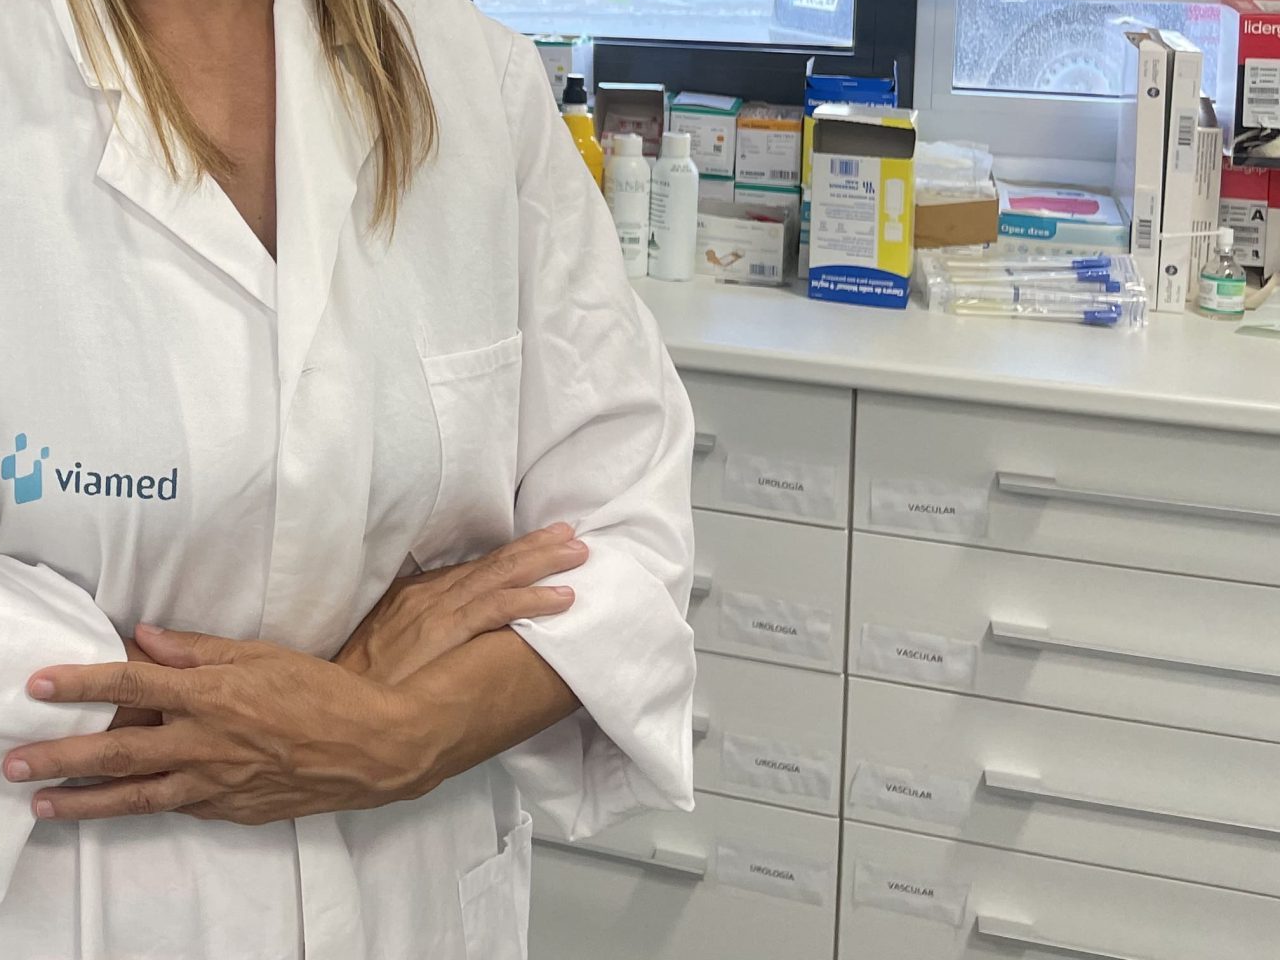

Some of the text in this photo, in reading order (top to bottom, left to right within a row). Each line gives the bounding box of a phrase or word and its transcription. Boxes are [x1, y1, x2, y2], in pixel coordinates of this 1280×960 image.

[55, 462, 178, 500] viamed
[758, 477, 804, 492] UROLOGÍA
[908, 503, 956, 515] VASCULAR
[896, 647, 943, 663] VASCULAR
[886, 783, 932, 800] VASCULAR
[887, 881, 934, 898] VASCULAR
